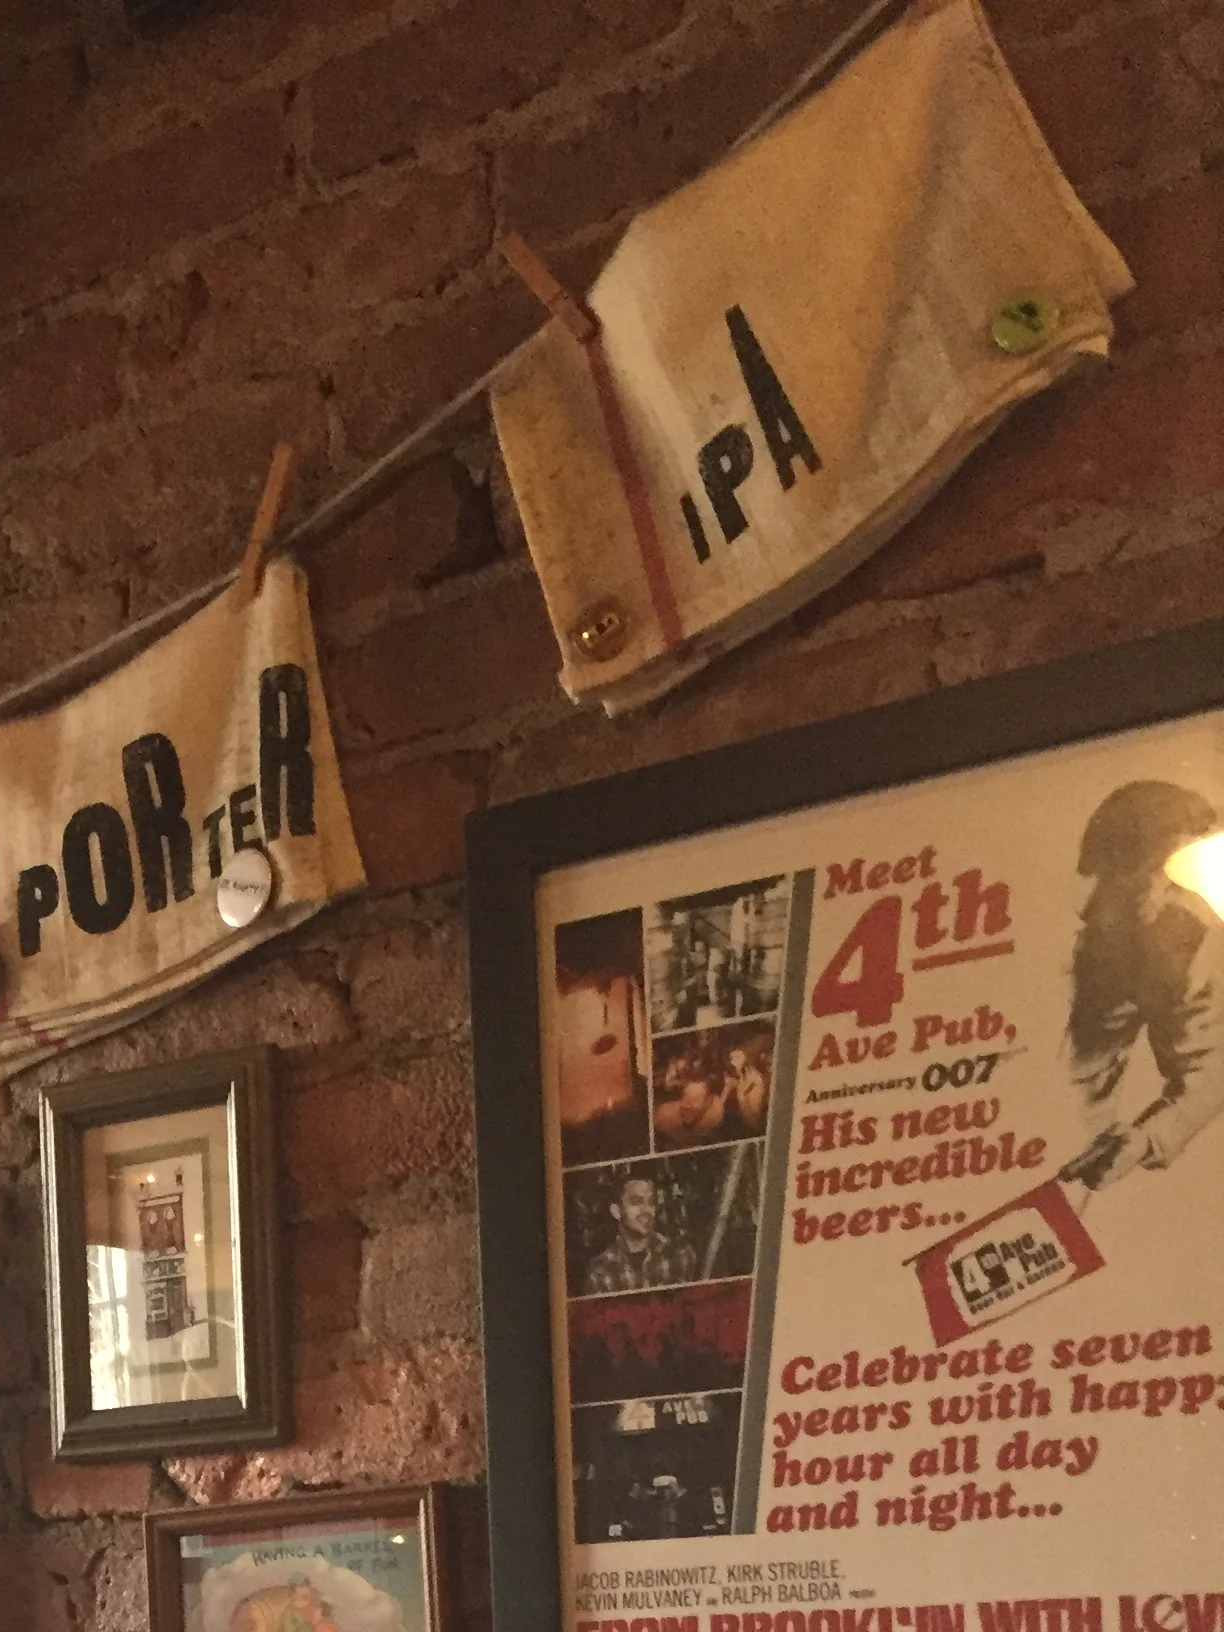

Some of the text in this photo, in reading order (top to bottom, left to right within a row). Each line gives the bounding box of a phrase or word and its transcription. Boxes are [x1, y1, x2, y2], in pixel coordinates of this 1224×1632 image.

[680, 304, 824, 564] IPA
[17, 663, 316, 958] PORTER
[825, 845, 937, 899] Meet
[812, 869, 1014, 1028] 4th
[809, 1004, 1017, 1070] Ave Pub,
[805, 1051, 1002, 1104] Anniversary 007
[800, 1097, 1001, 1154] His new
[796, 1132, 1047, 1200] incredible
[792, 1201, 966, 1246] beers...
[781, 1325, 1213, 1395] Celebrate seven
[773, 1395, 912, 1447] years
[929, 1378, 1052, 1428] with
[772, 1430, 1099, 1487] hour all day
[766, 1482, 1063, 1533] and night...
[576, 1571, 620, 1590] JACOB
[726, 1563, 764, 1583] KIRK
[576, 1591, 618, 1611] KEVIN
[622, 1586, 702, 1609] MULVANEY
[722, 1584, 772, 1606] RALPH
[777, 1581, 842, 1604] BALBOA
